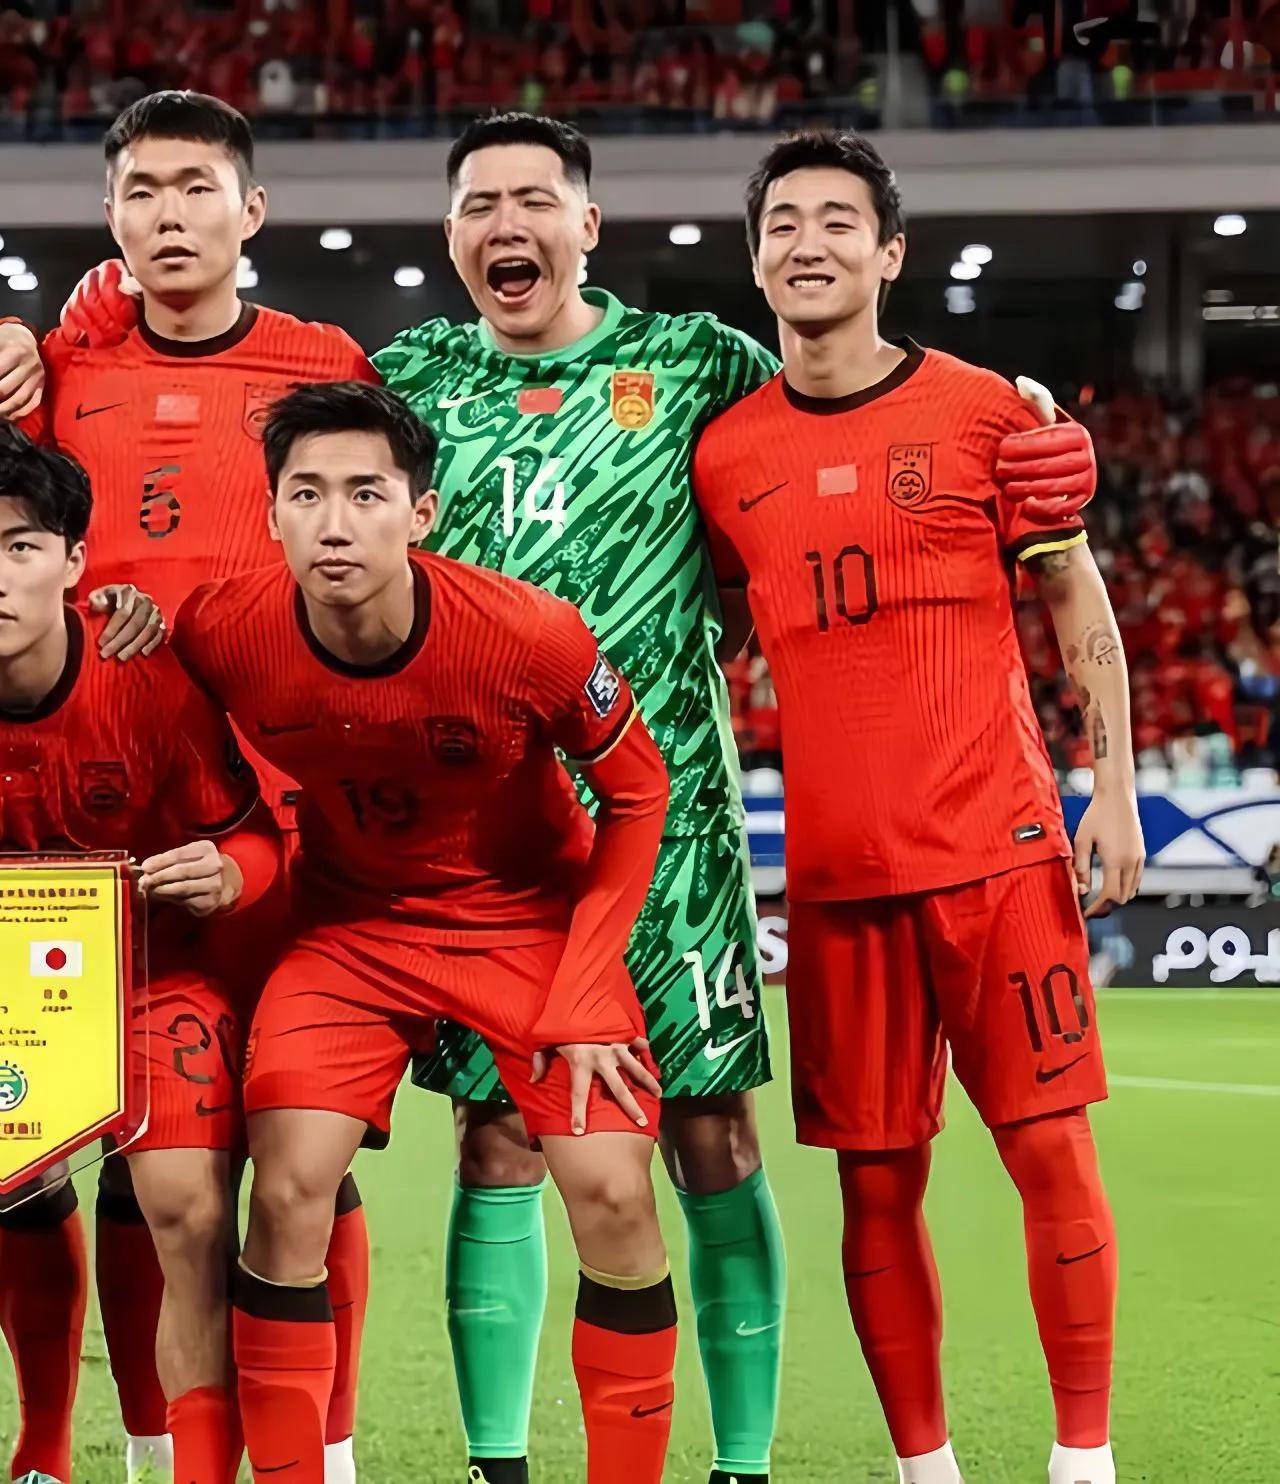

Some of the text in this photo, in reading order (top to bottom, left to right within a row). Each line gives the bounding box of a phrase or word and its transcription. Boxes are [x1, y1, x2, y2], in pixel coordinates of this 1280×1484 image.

[497, 456, 567, 538] 14
[805, 544, 878, 632] 10
[682, 941, 755, 1030] 14
[1007, 963, 1089, 1053] 10
